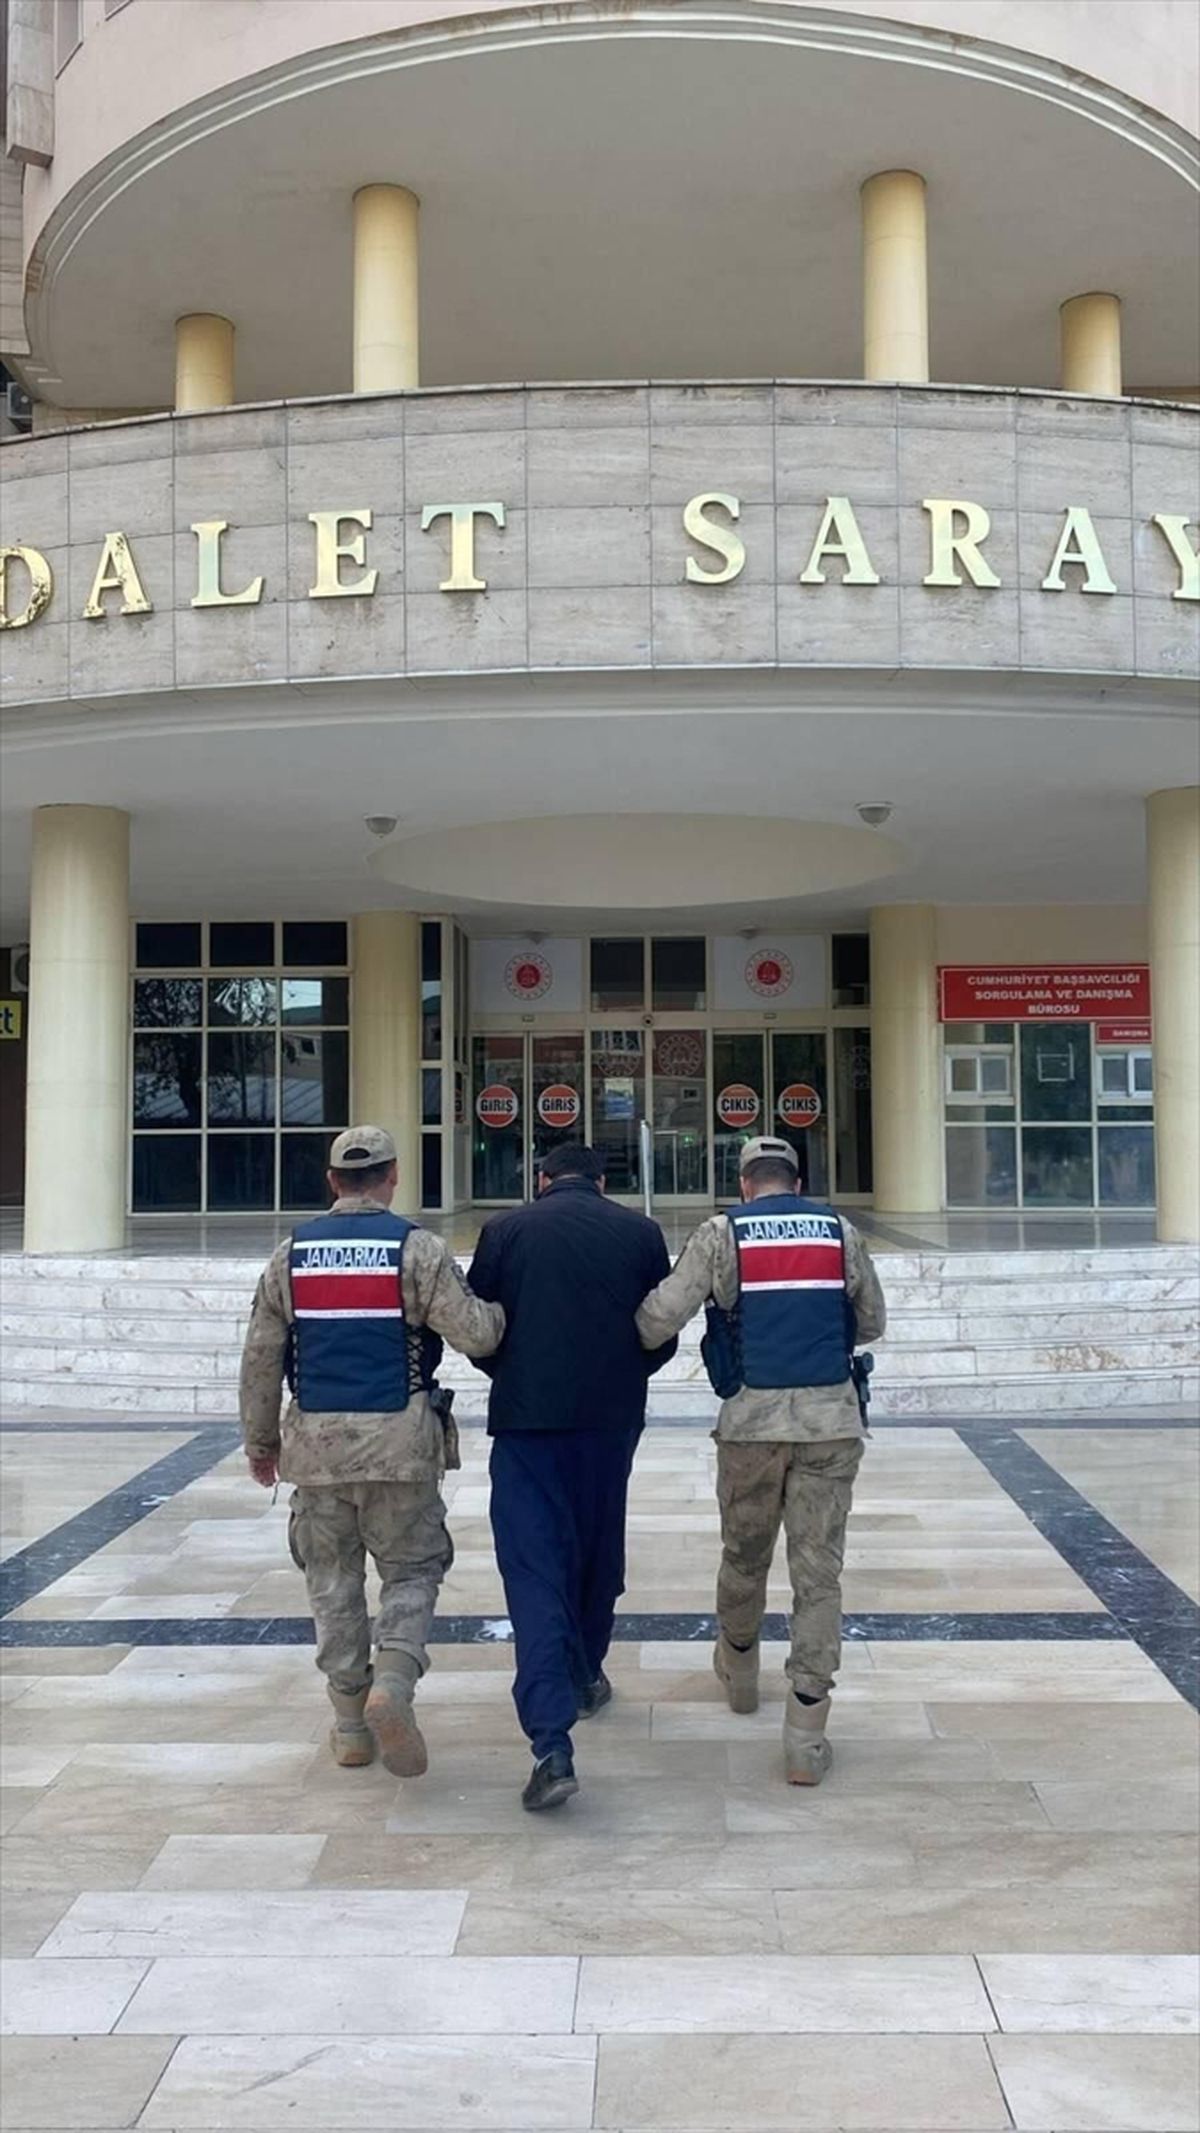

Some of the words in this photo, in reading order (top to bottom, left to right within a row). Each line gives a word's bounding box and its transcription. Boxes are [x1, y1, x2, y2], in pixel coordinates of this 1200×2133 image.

[0, 501, 507, 630] DALET
[682, 492, 1200, 600] SARAY
[967, 973, 1050, 986] CUMHURİYET
[1053, 973, 1140, 987] BAŞSAVCILIĞI
[975, 989, 1053, 1000] SORGULAMA
[1056, 989, 1073, 999] VE
[1076, 988, 1134, 1001] DANIŞMA
[1028, 1003, 1080, 1014] BÜROSU
[744, 1219, 832, 1240] JANDARMA
[301, 1246, 390, 1268] JANDARMA
